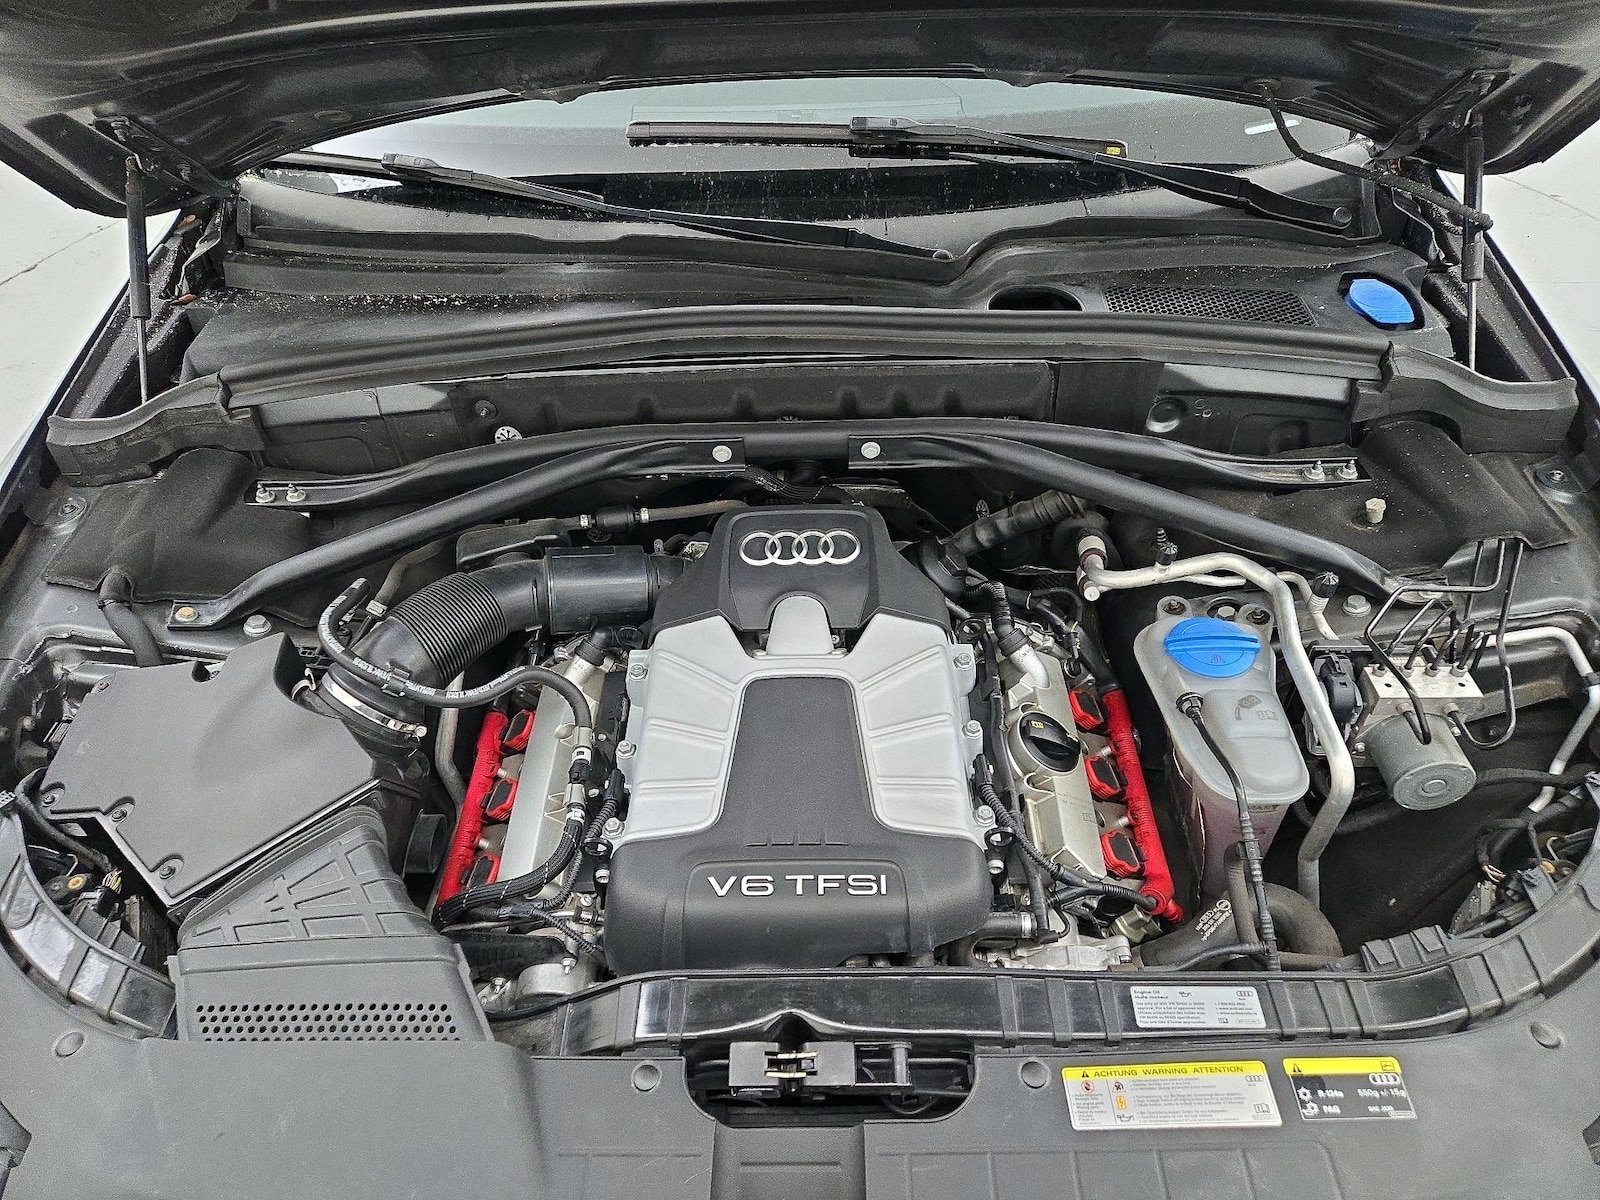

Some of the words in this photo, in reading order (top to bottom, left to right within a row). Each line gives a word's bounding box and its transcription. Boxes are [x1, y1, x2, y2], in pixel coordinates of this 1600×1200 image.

[707, 875, 775, 897] V6
[785, 874, 887, 896] TFSI
[1093, 1069, 1138, 1078] ACHTUNG
[1142, 1067, 1188, 1076] WARNING
[1192, 1065, 1244, 1074] ATTENTION
[1317, 1089, 1344, 1098] R-134a
[1357, 1088, 1380, 1098] 550g
[1389, 1087, 1407, 1097] 15g
